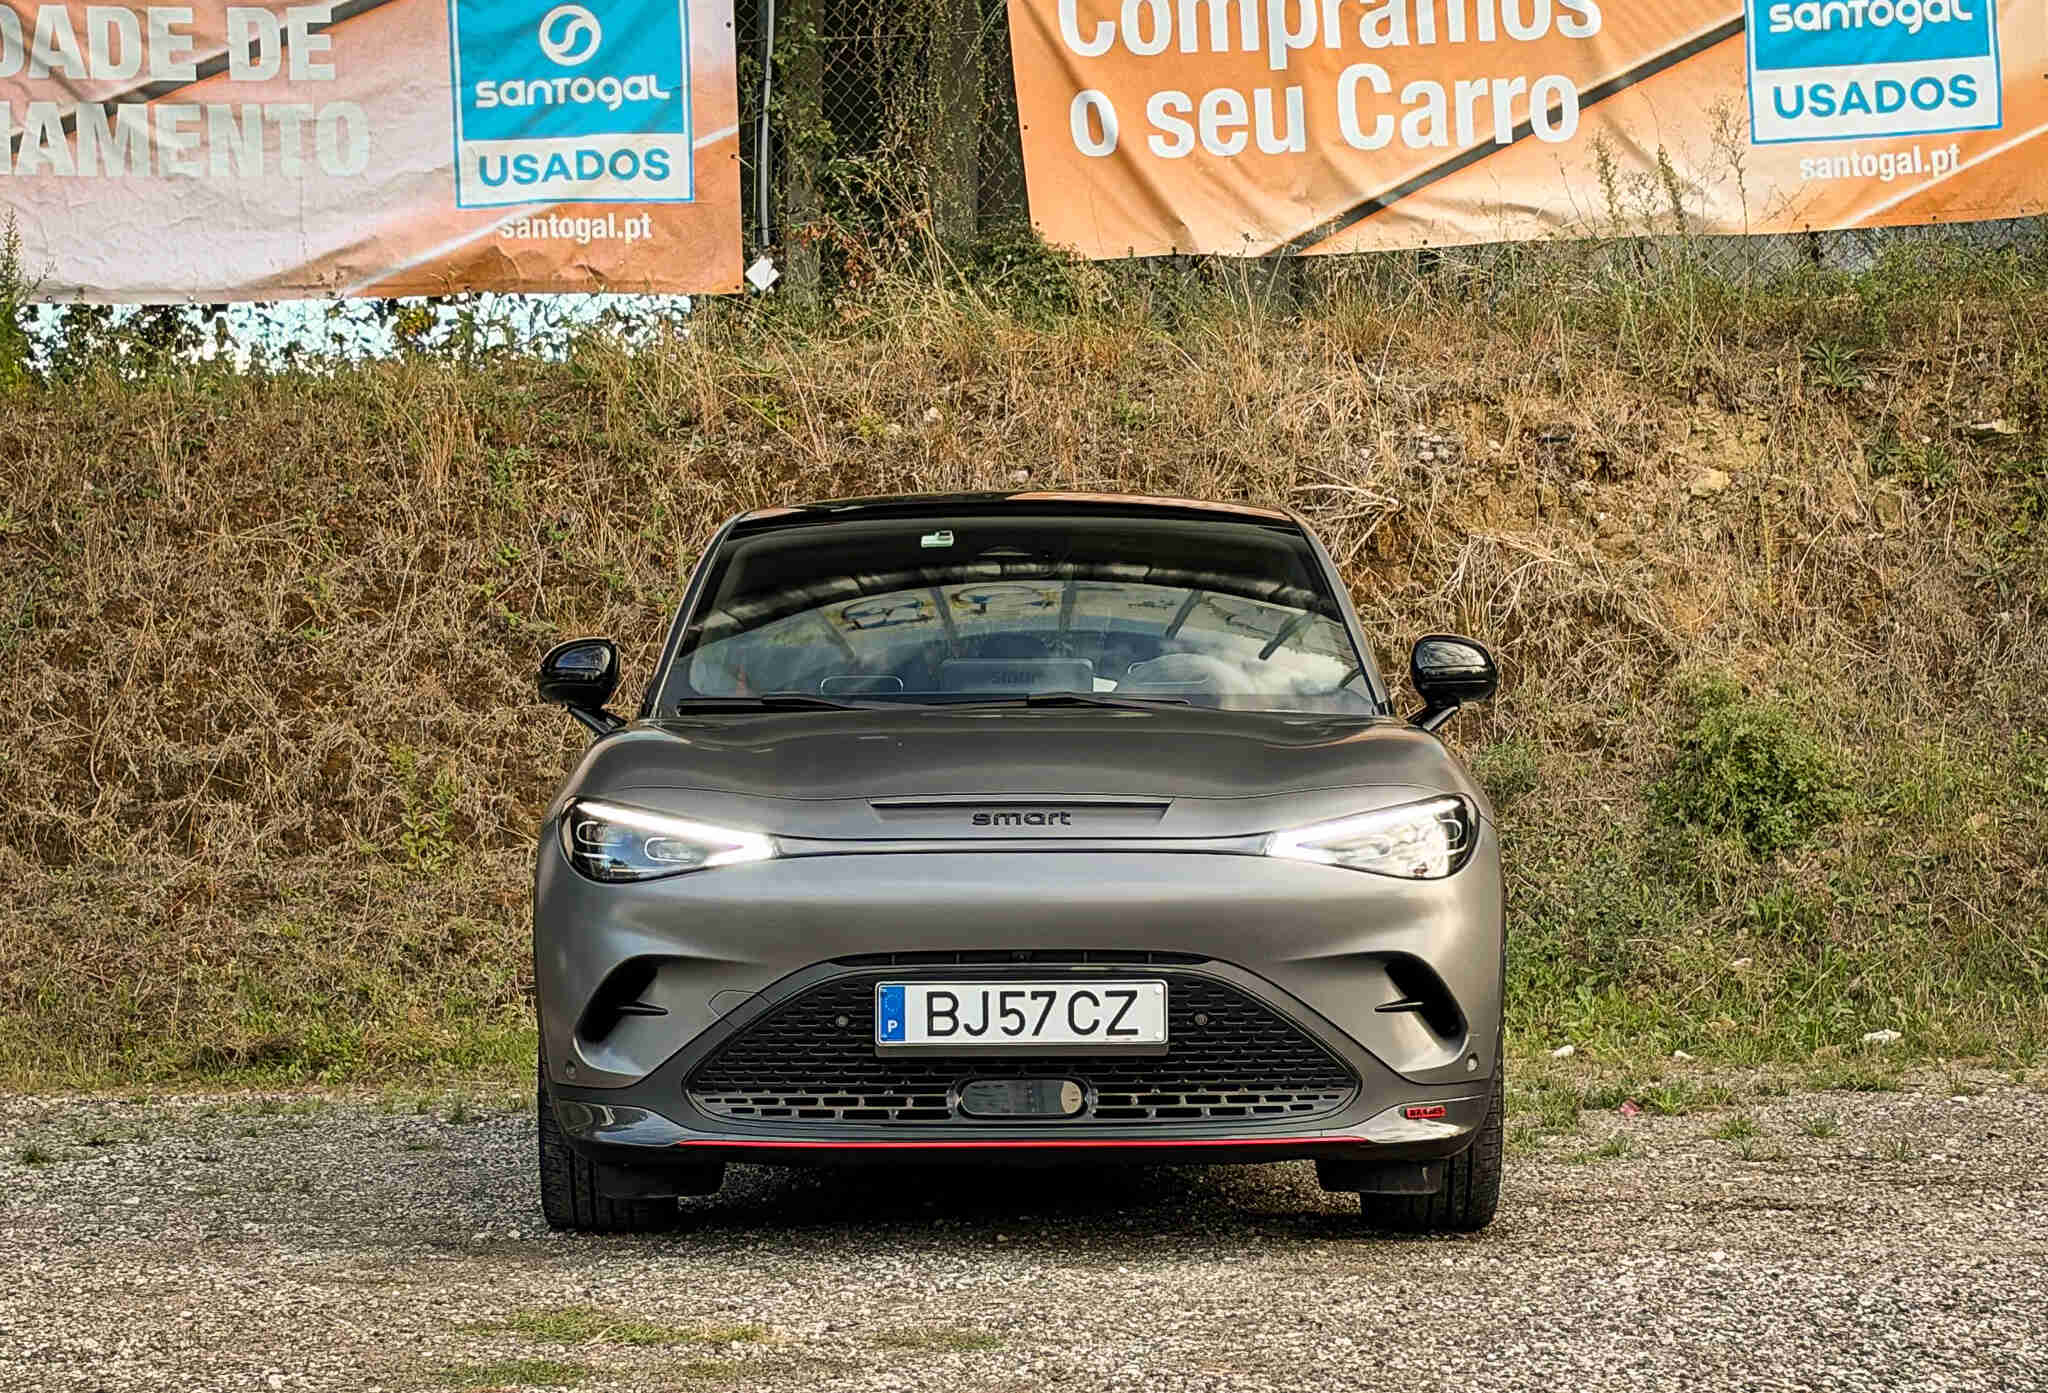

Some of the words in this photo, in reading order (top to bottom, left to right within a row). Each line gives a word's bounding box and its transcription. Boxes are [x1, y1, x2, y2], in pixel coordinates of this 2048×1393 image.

[227, 7, 337, 81] DE
[1058, 0, 1602, 70] Compramos
[1070, 89, 1118, 157] o
[1146, 85, 1306, 159] seu
[1337, 63, 1579, 150] Carro
[1773, 74, 1977, 119] USADOS
[478, 148, 670, 186] USADOS
[1800, 143, 1961, 181] santogal.pt
[500, 212, 652, 243] santogal.pt
[972, 811, 1072, 826] smart
[887, 1020, 898, 1033] P
